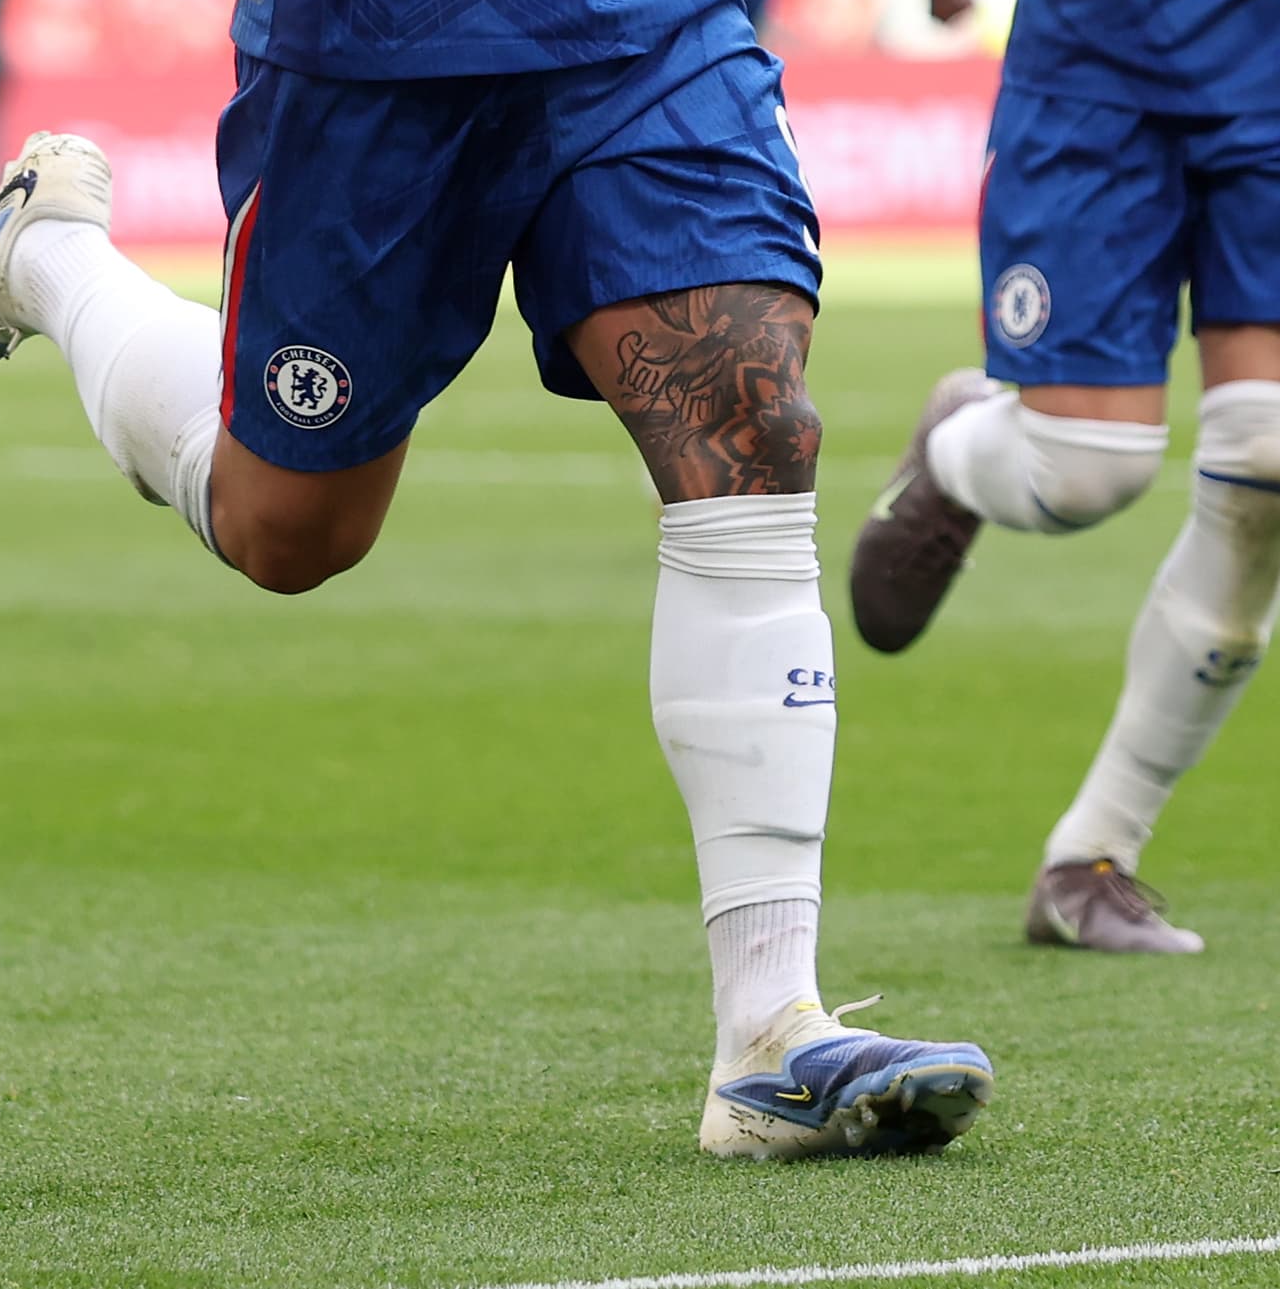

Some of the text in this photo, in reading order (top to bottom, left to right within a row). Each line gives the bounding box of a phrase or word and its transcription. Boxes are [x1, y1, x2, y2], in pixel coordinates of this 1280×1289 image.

[281, 349, 337, 372] CHELSEA
[276, 402, 335, 424] FOOTBALL CLUB
